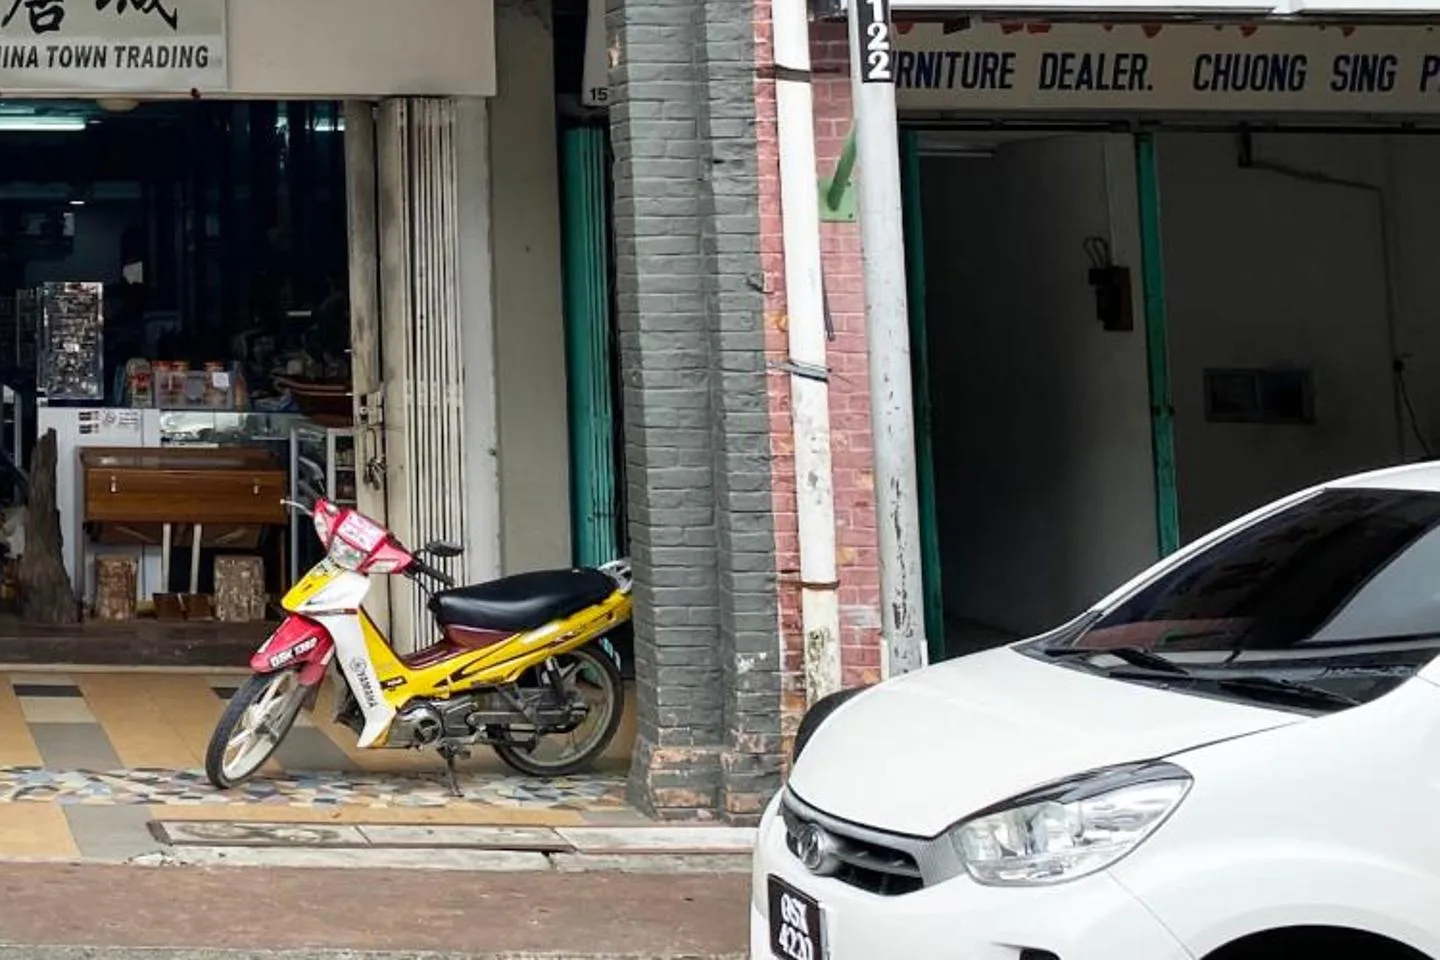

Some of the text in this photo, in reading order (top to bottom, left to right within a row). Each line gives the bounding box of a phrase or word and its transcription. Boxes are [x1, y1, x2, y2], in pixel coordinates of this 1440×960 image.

[47, 45, 108, 69] TOWN
[115, 45, 209, 69] TRADING
[891, 50, 1016, 90] RNITURE
[1039, 52, 1154, 91] DEALER.
[1193, 53, 1308, 92] CHUONG
[1331, 53, 1398, 92] SING
